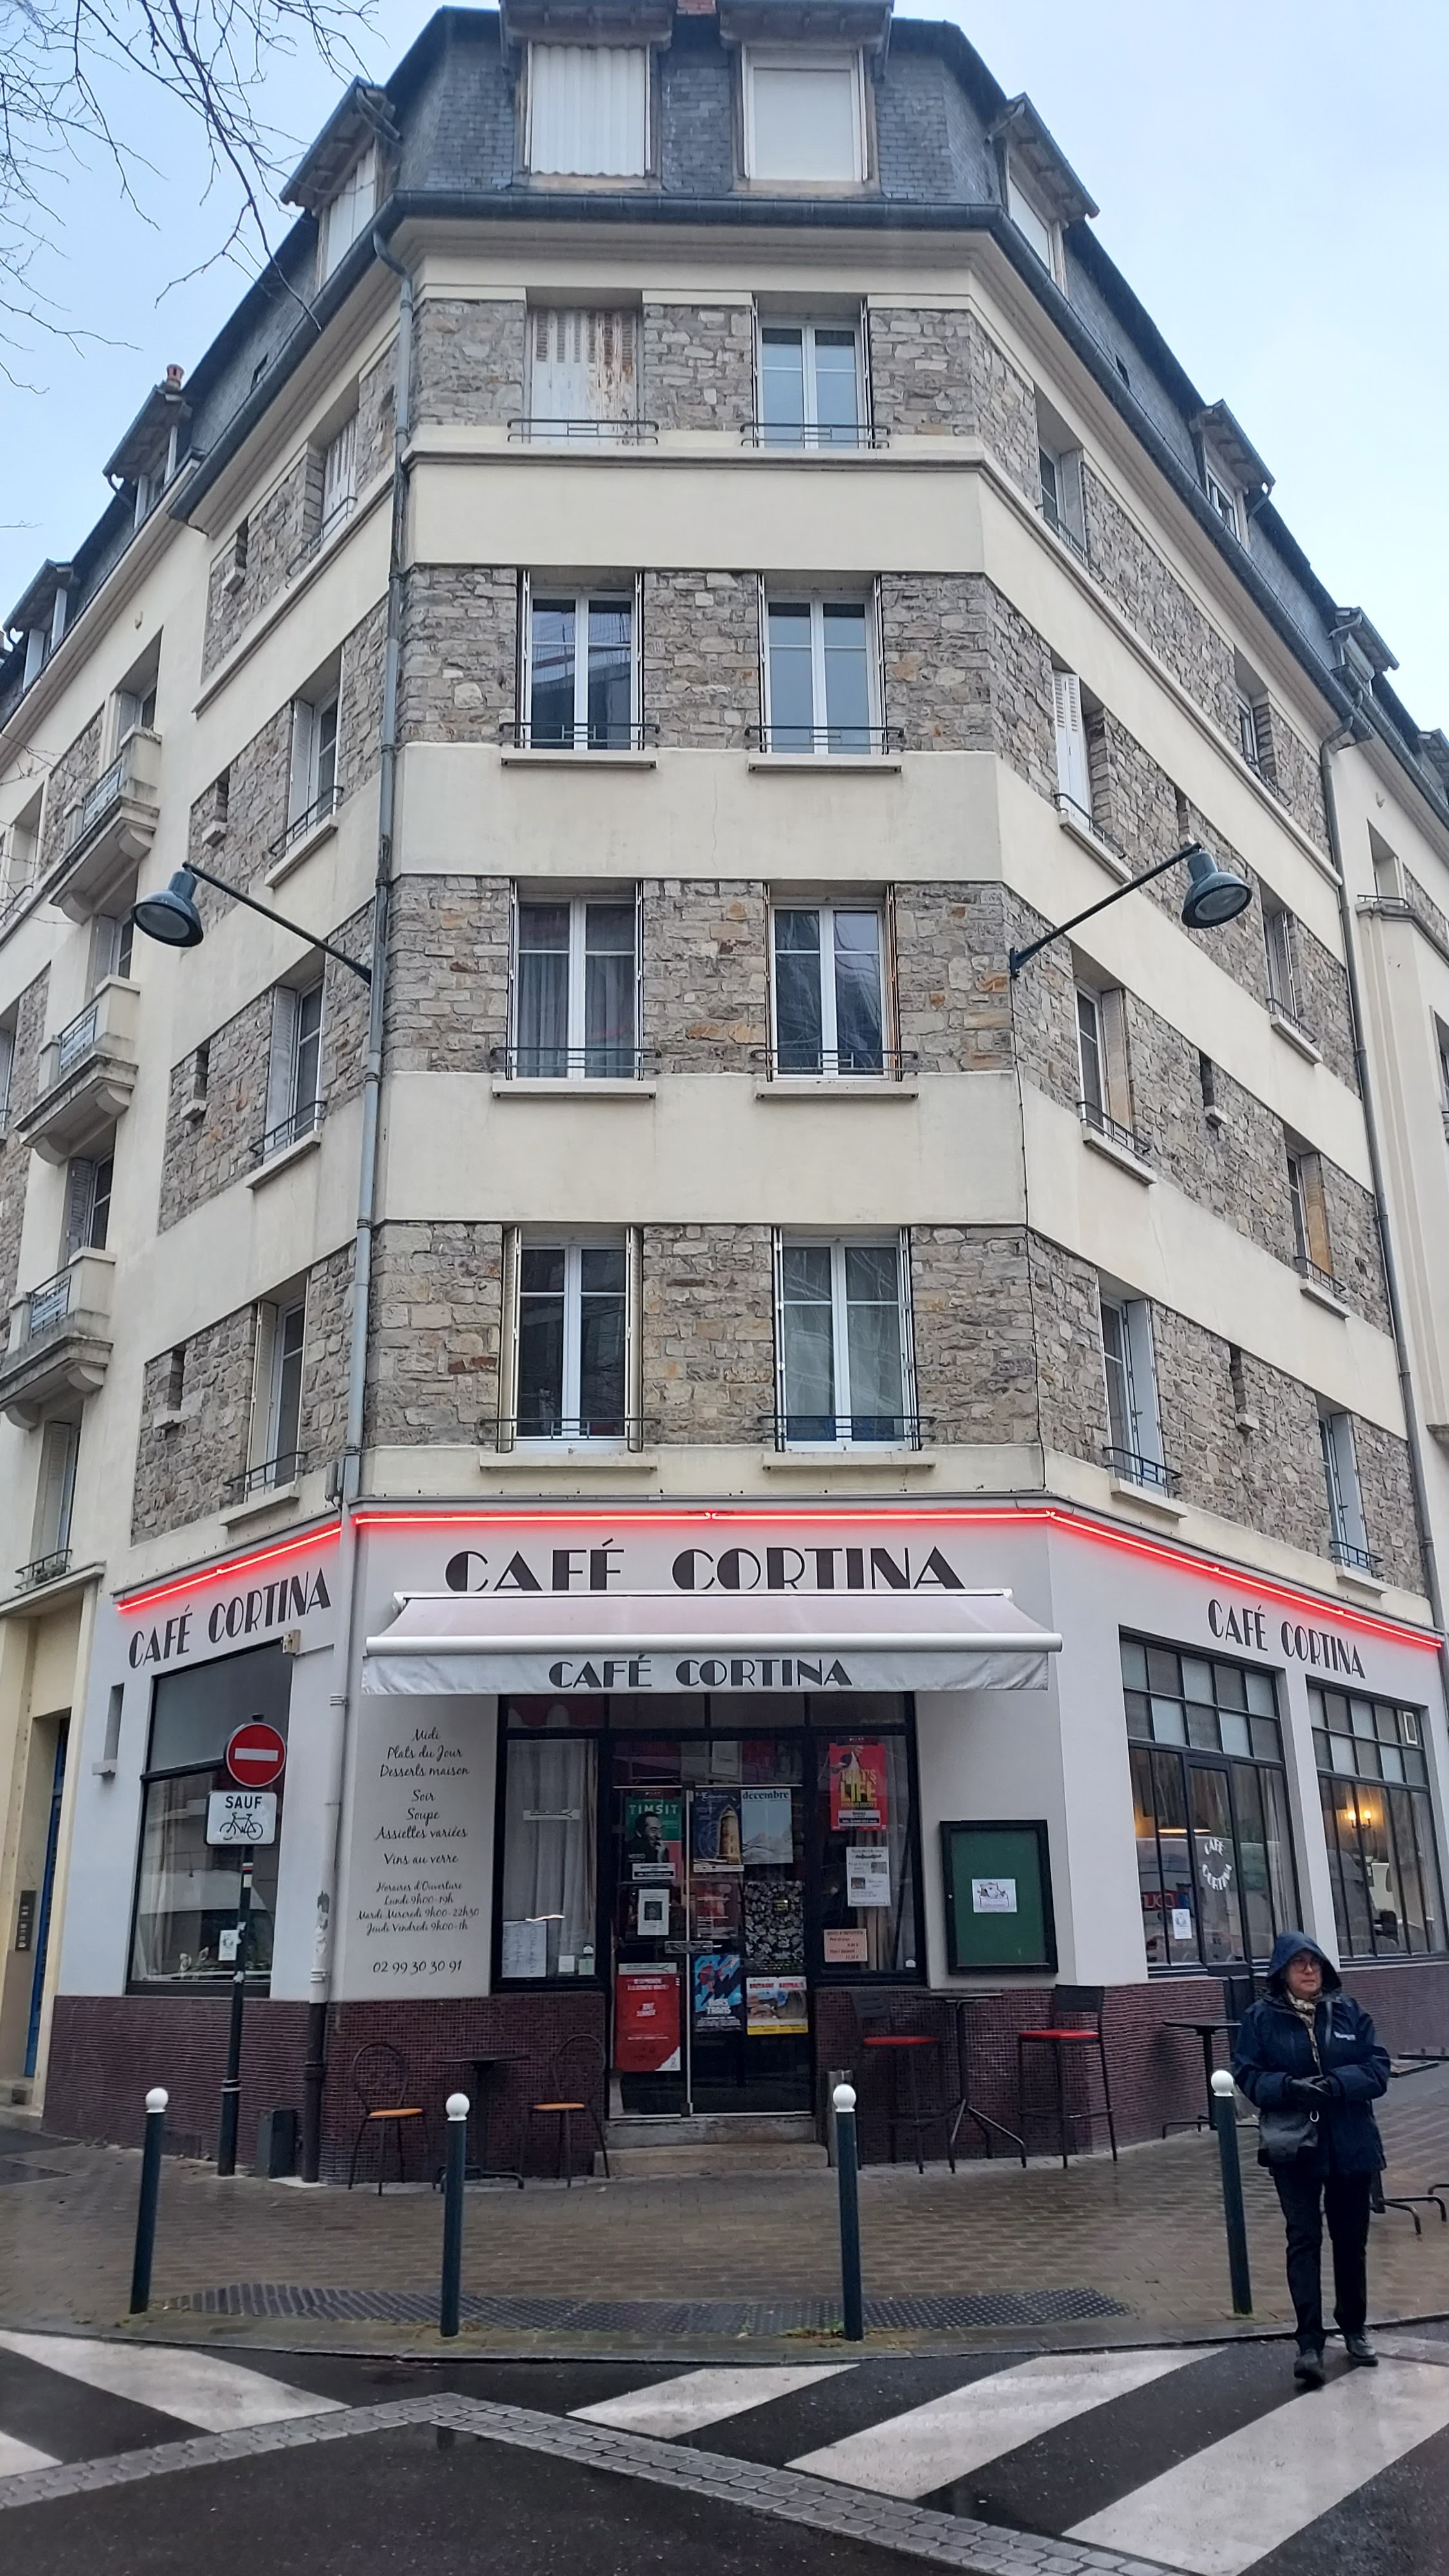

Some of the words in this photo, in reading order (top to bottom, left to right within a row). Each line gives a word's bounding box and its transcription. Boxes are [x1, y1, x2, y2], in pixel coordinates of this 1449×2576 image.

[445, 1538, 625, 1591] CAFÉ
[672, 1546, 967, 1591] CORTINA
[129, 1604, 193, 1669] CAFÉ
[208, 1567, 332, 1643] CORTINA
[1208, 1599, 1269, 1652] CAFÉ
[1280, 1621, 1366, 1680] CORTINA
[549, 1654, 652, 1689] CAFÉ
[675, 1658, 853, 1688] CORTINA
[411, 1726, 442, 1742] Midi
[387, 1745, 415, 1760] Plats
[418, 1745, 435, 1758] du
[436, 1745, 464, 1763] Jour
[379, 1763, 426, 1778] Desserts
[428, 1766, 471, 1776] maison
[411, 1788, 436, 1803] Soir
[840, 1781, 877, 1802] LIFE
[225, 1795, 263, 1810] SAUF
[629, 1804, 679, 1815] TIMSIT
[406, 1807, 440, 1827] Soupe
[374, 1825, 427, 1841] Assiettes
[430, 1826, 468, 1837] variées
[384, 1853, 410, 1865] Vins
[430, 1854, 459, 1864] verre
[376, 1881, 412, 1893] Horaires
[384, 1894, 409, 1905] Lundi
[355, 1908, 383, 1920] Mardi
[387, 1907, 422, 1920] Mercredi
[366, 1922, 389, 1936] Jeudi
[392, 1921, 428, 1932] Vendredi
[372, 1961, 388, 1973] 02
[392, 1962, 408, 1975] 99
[410, 1960, 427, 1976] 30
[428, 1960, 446, 1975] 30
[449, 1960, 462, 1973] 91
